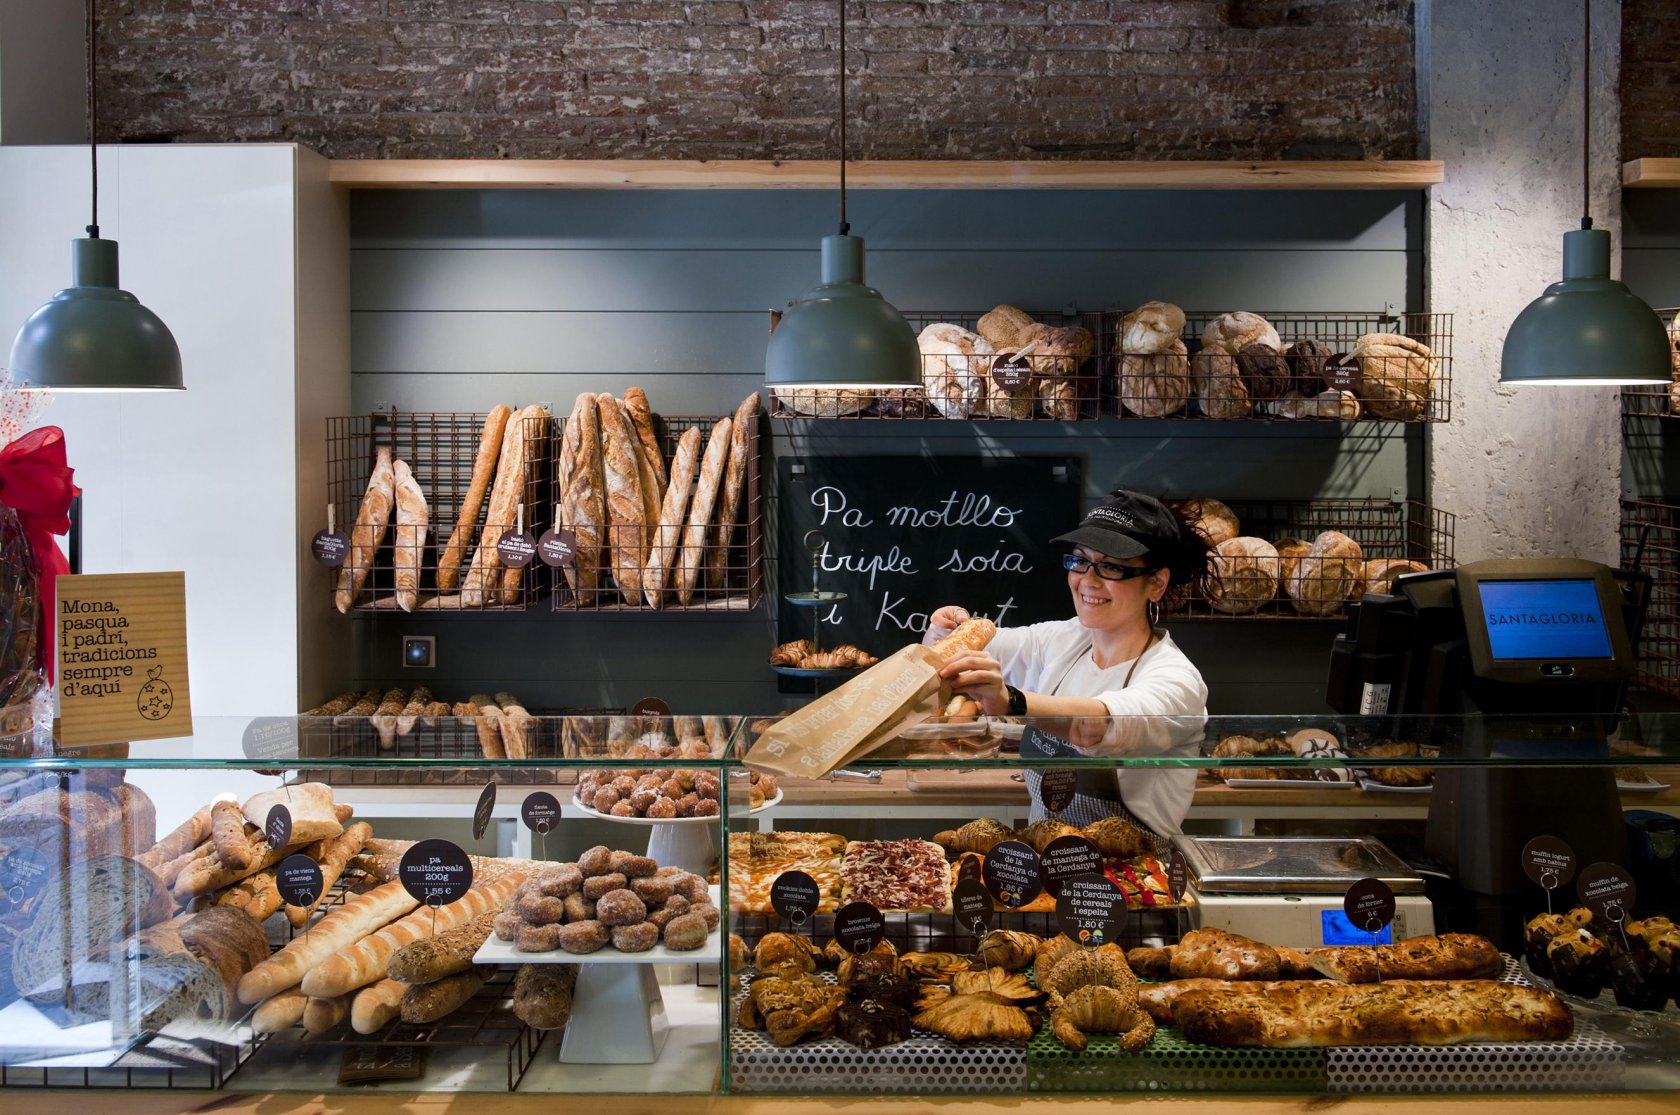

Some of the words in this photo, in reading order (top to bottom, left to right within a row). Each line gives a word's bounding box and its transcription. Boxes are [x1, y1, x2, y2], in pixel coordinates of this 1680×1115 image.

[811, 486, 873, 527] Pa
[886, 490, 1023, 528] motllo
[820, 541, 919, 591] triple
[938, 539, 1033, 573] soia
[62, 600, 120, 615] Mona,
[821, 604, 843, 624] i
[1489, 613, 1596, 625] SANTAGLORIA
[62, 616, 129, 633] pasqua
[62, 634, 67, 647] i
[73, 631, 128, 649] padrí,
[63, 647, 157, 664] tradicions
[63, 664, 133, 680] sempre
[63, 680, 121, 697] d'aquí
[766, 736, 791, 758] si
[998, 847, 1033, 860] croissant
[1051, 845, 1088, 856] croissant
[1015, 858, 1023, 866] la
[1042, 858, 1052, 866] de
[1053, 854, 1088, 865] mantega
[1547, 859, 1567, 867] nabius
[1552, 853, 1570, 861] iogurt
[990, 860, 1026, 875] Cerdanya
[1057, 862, 1096, 872] Cerdanya
[997, 871, 1029, 884] xocolata
[1589, 879, 1610, 888] muffin
[1073, 882, 1111, 890] croissant
[1585, 886, 1611, 897] xocolata
[1083, 891, 1122, 901] Cerdanya
[1082, 900, 1112, 908] cereals
[1079, 907, 1108, 917] espelta
